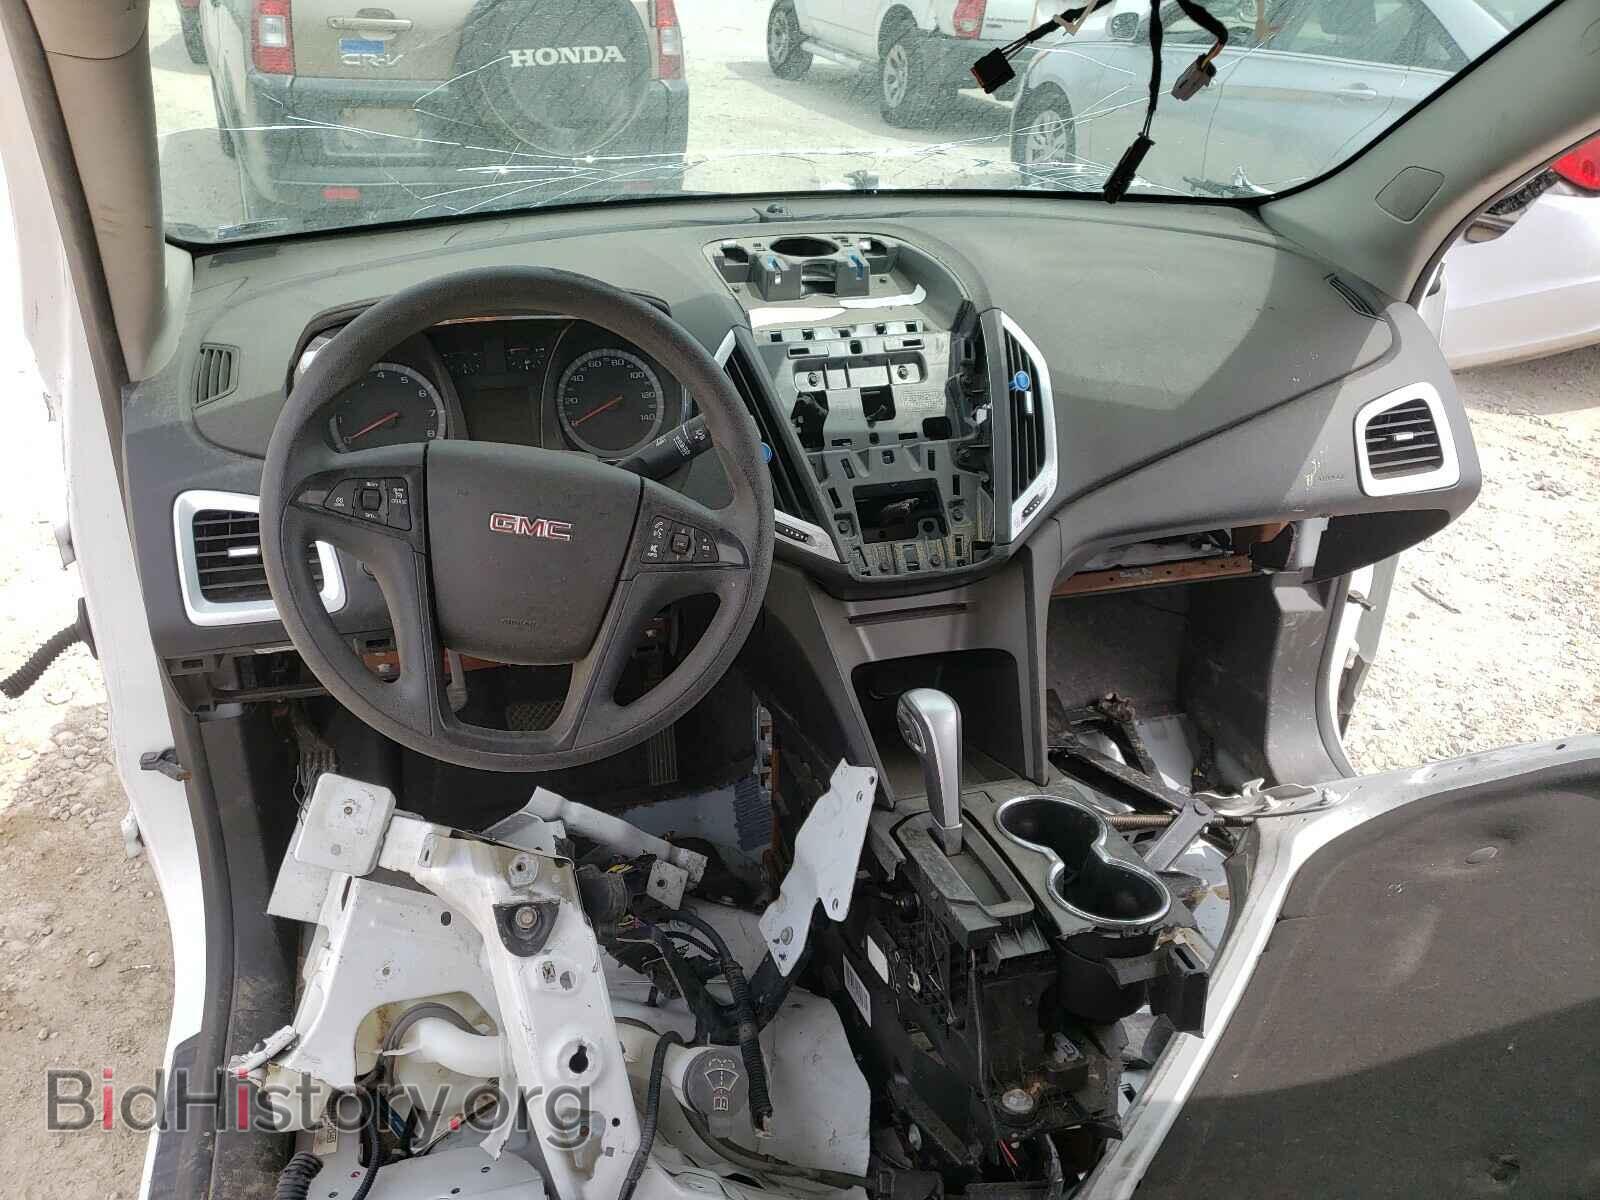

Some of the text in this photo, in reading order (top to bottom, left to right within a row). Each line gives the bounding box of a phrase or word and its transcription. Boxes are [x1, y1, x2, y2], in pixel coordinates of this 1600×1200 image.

[341, 53, 405, 67] CR-V
[509, 45, 626, 68] HONDA
[630, 371, 645, 379] 100
[401, 376, 409, 384] 5
[418, 389, 428, 398] 6
[640, 413, 655, 421] 140
[490, 512, 572, 542] GMC
